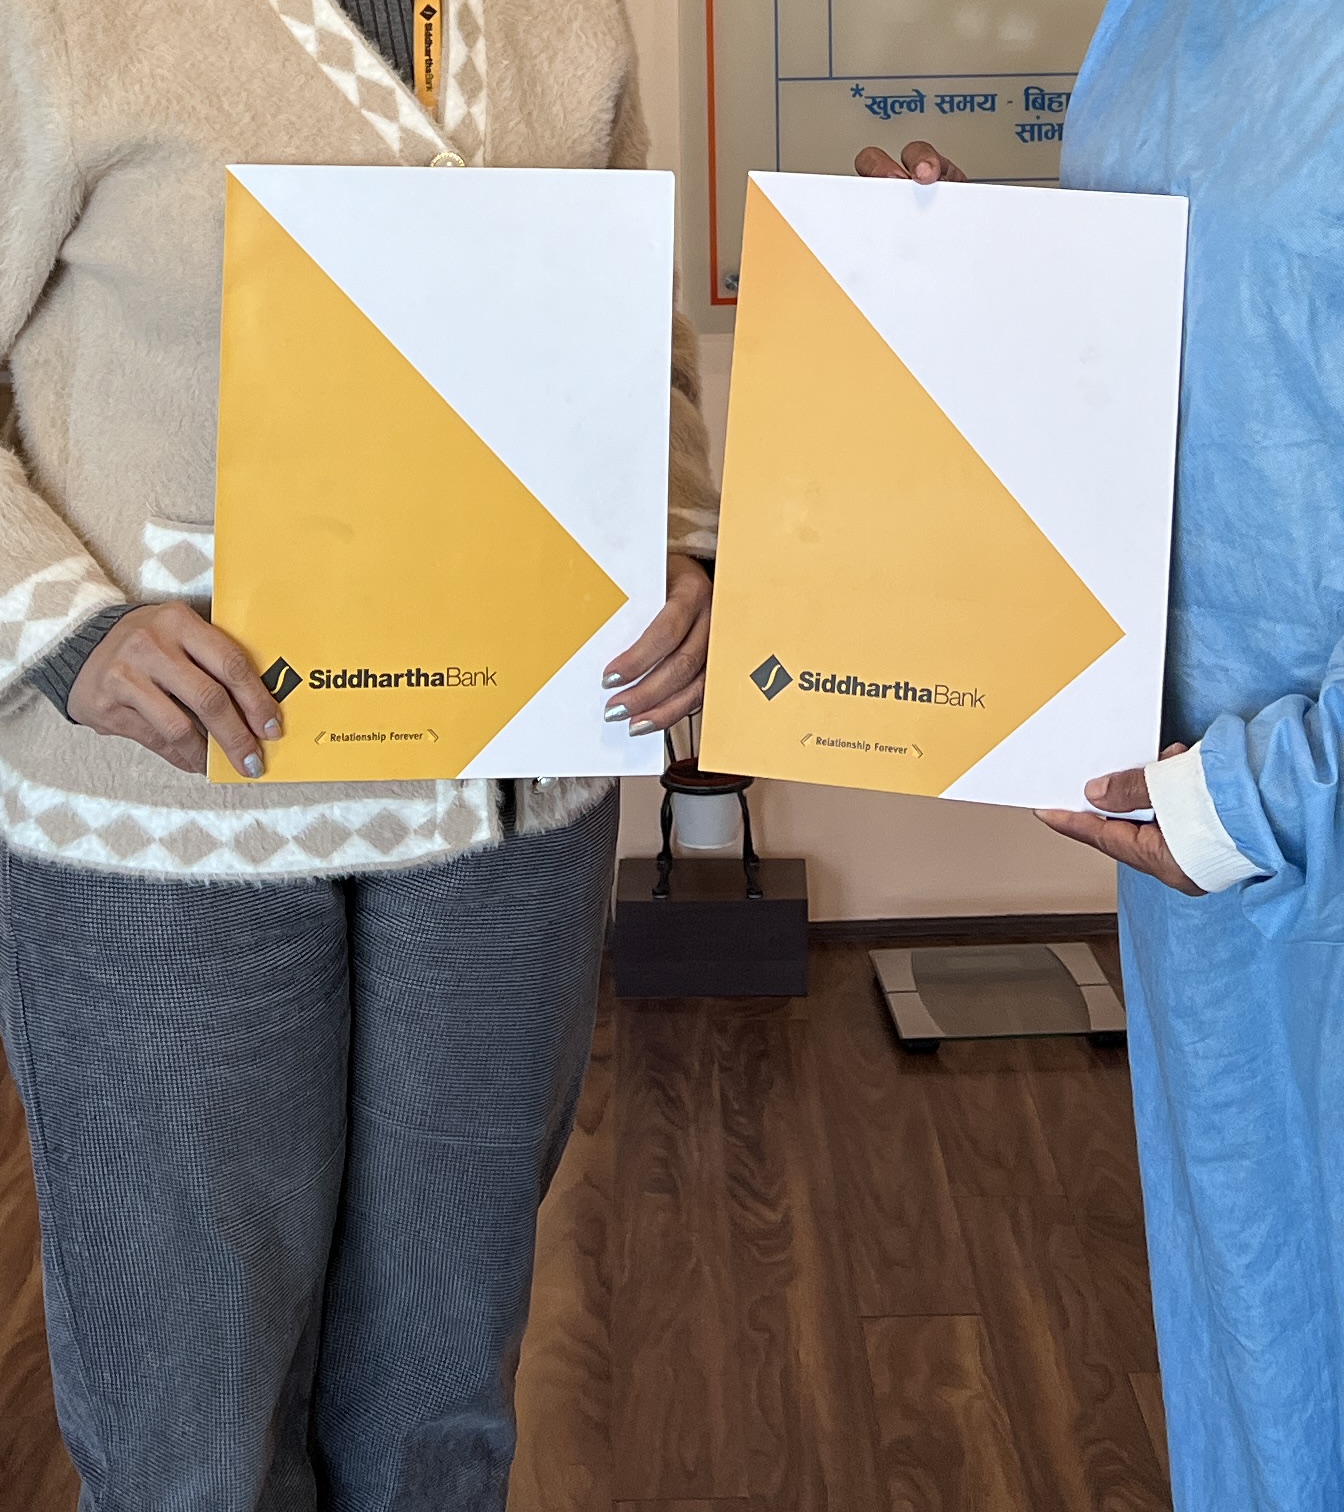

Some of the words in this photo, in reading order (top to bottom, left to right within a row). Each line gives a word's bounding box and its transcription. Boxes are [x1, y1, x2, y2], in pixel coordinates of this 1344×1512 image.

[935, 93, 998, 115] समय
[309, 667, 498, 689] SiddharthaBank
[798, 671, 986, 709] SiddharthaBank
[330, 731, 387, 743] Relationship
[390, 731, 423, 741] Forever
[816, 736, 871, 752] Relationship
[874, 742, 908, 755] Forever
